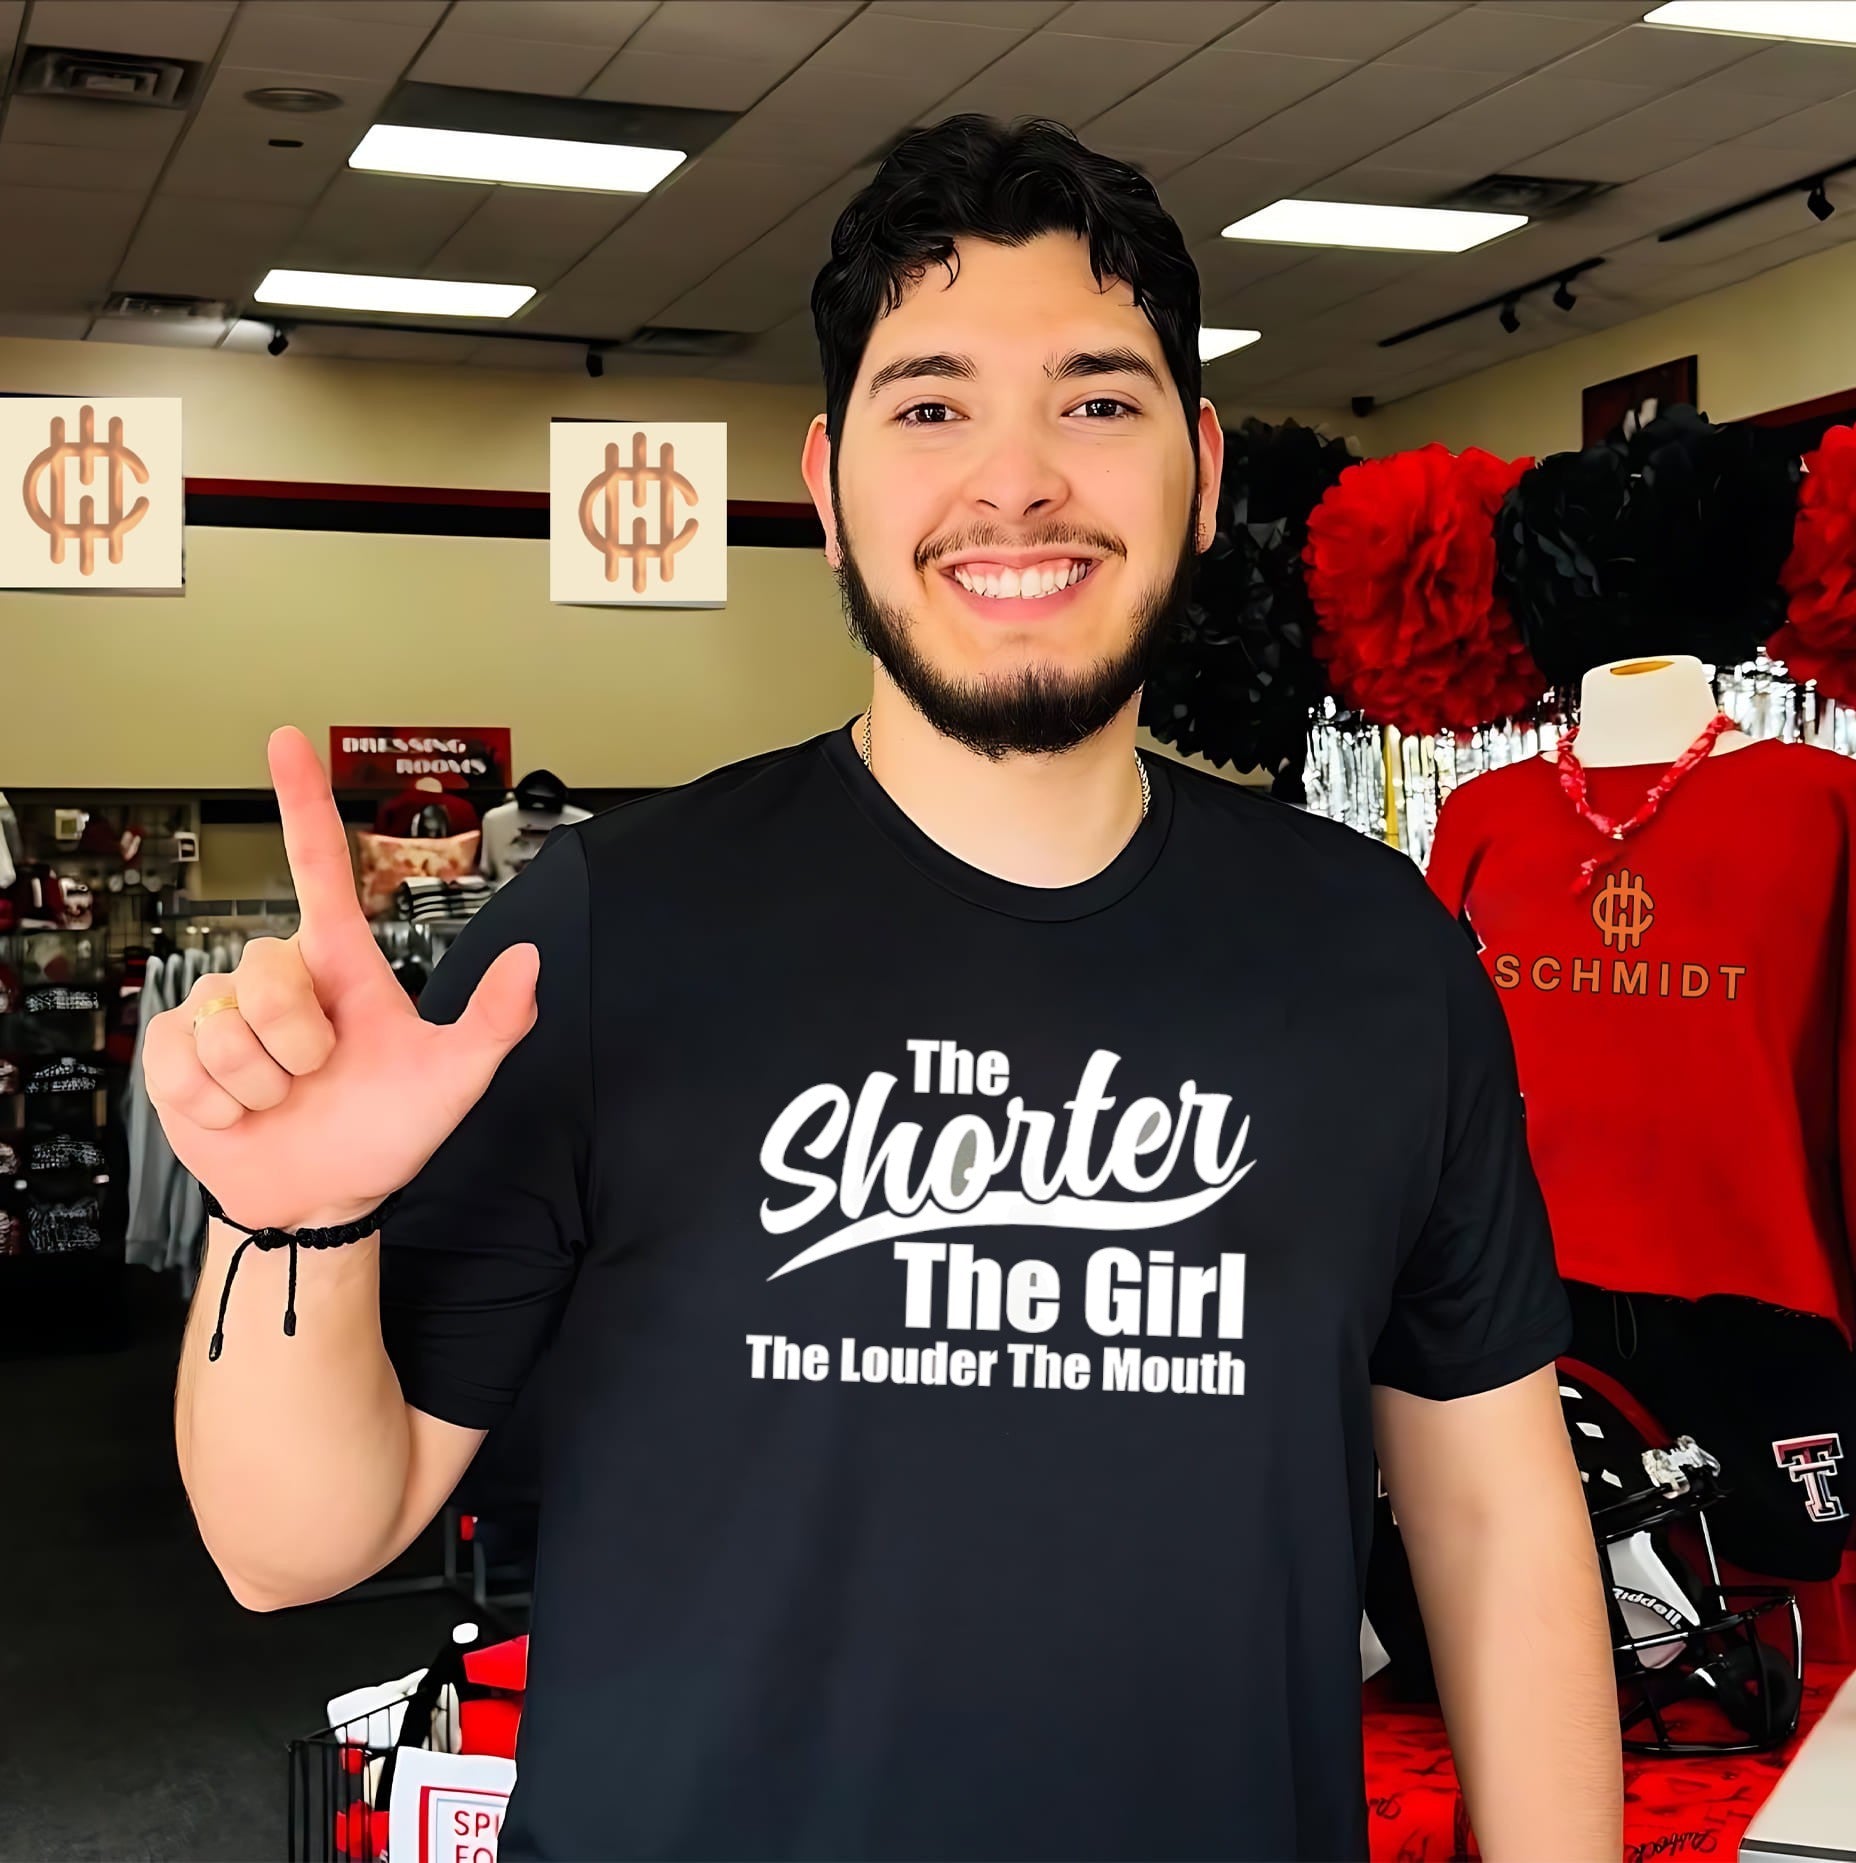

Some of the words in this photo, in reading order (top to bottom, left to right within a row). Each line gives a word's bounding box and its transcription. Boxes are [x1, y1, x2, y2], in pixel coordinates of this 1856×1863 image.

[342, 737, 467, 754] DRESSING
[396, 758, 487, 775] ROOMS
[1494, 953, 1747, 1000] SCHMIDT
[907, 1039, 1010, 1096] The
[759, 1048, 1251, 1235] Shorter
[893, 1241, 1061, 1334] The
[1085, 1246, 1247, 1339] Girl
[746, 1333, 830, 1382] The
[840, 1337, 999, 1388] Louder
[1006, 1343, 1092, 1391] The
[1102, 1346, 1246, 1396] Mouth
